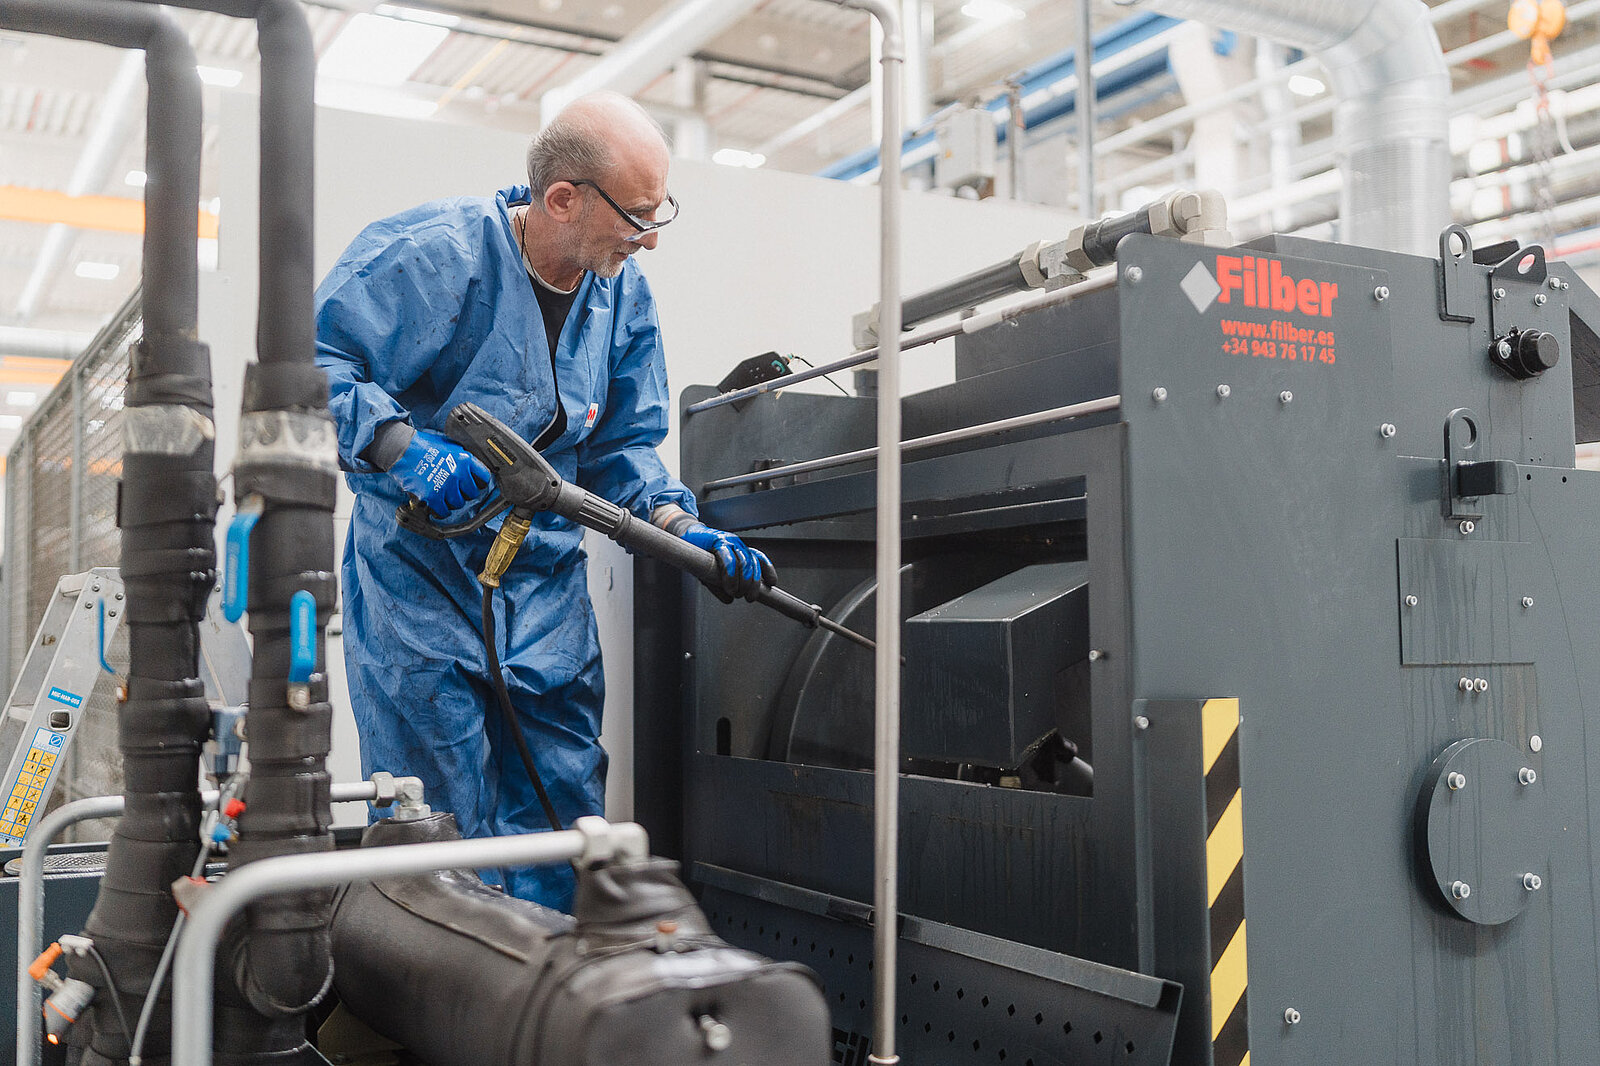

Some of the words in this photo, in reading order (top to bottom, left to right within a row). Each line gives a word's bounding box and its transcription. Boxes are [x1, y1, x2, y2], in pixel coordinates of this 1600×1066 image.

[1216, 254, 1338, 317] Filber
[1220, 319, 1335, 347] www.filber.es
[1221, 337, 1248, 355] +34
[1251, 339, 1276, 359] 943
[1279, 343, 1297, 361] 76
[1300, 345, 1315, 362] 17
[1318, 348, 1336, 365] 45
[433, 470, 450, 493] NITRAS
